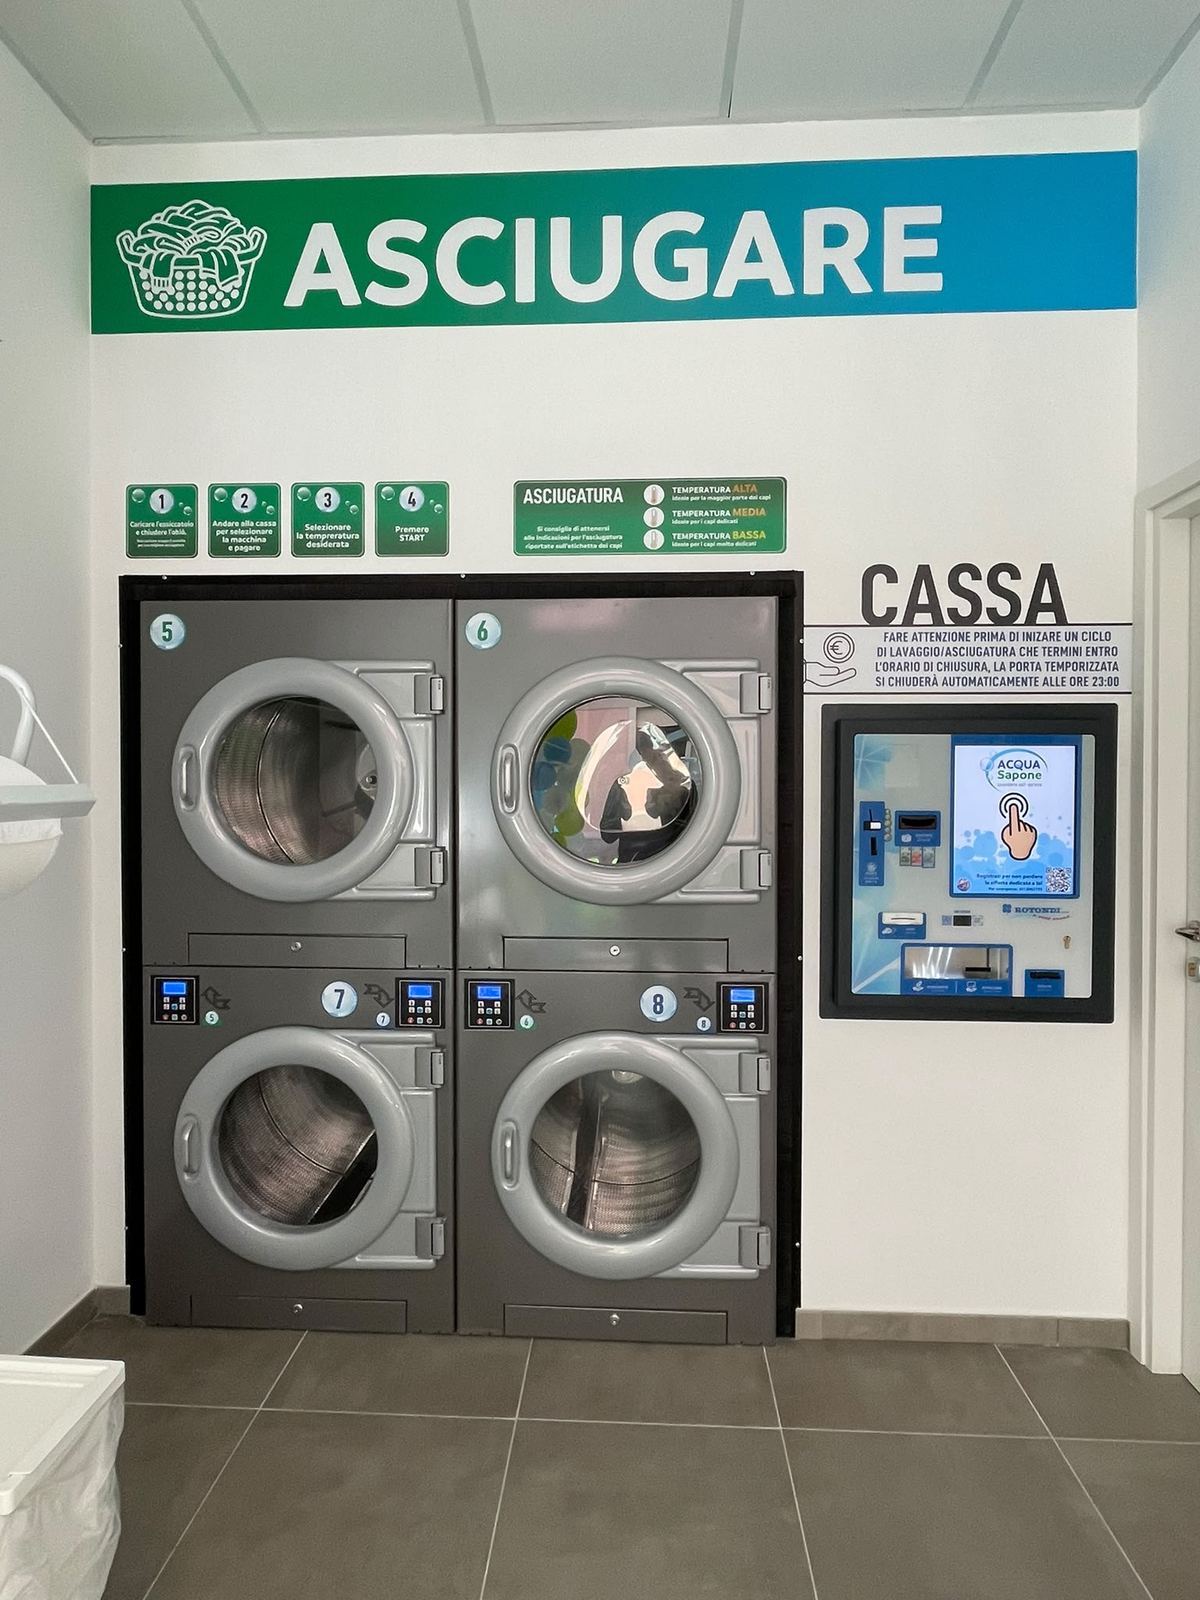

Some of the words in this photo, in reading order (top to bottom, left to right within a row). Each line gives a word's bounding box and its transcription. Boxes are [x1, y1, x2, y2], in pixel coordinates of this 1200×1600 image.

[283, 205, 943, 307] ASCIUGARE
[672, 486, 731, 494] TEMPERATURA
[732, 484, 758, 493] ALTA
[158, 494, 165, 509] 1
[240, 493, 249, 509] 2
[323, 492, 332, 508] 3
[407, 491, 417, 507] 4
[523, 487, 624, 504] ASCIUGATURA
[732, 508, 767, 517] MEDIA
[305, 523, 351, 531] Selezionare
[399, 534, 425, 542] START
[732, 531, 767, 540] BASSA
[861, 562, 1069, 626] CASSA
[162, 621, 173, 642] 5
[477, 620, 489, 642] 6
[884, 632, 908, 643] FARE
[911, 631, 971, 642] ATTENZIONE
[974, 631, 1006, 642] PRIMA
[1009, 631, 1019, 642] DI
[1022, 631, 1062, 642] INIZARE
[1064, 631, 1079, 642] UN
[1082, 631, 1112, 642] CICLO
[877, 647, 887, 657] DI
[890, 646, 1016, 657] LAVAGGIO/ASCIUGATURA
[1019, 646, 1039, 657] CHE
[1042, 646, 1082, 657] TERMINI
[1086, 646, 1118, 657] ENTRO
[875, 661, 920, 672] L'ORARIO
[923, 661, 934, 672] DI
[936, 661, 991, 673] CHIUSURA,
[994, 661, 1006, 672] LA
[1009, 661, 1042, 672] PORTA
[1045, 661, 1120, 672] TEMPORIZZATA
[875, 676, 885, 687] SI
[888, 674, 938, 687] CHIUDERÀ
[942, 676, 1040, 687] AUTOMATICAMENTE
[1042, 676, 1066, 687] ALLE
[1069, 676, 1089, 687] ORE
[1092, 676, 1120, 687] 23:00
[997, 759, 1041, 771] ACQUA
[997, 770, 1042, 781] Sapone
[334, 989, 345, 1010] 7
[652, 994, 664, 1015] 8
[209, 1014, 215, 1022] 5
[380, 1015, 386, 1023] 7
[524, 1018, 529, 1026] 6
[701, 1020, 706, 1028] 8
